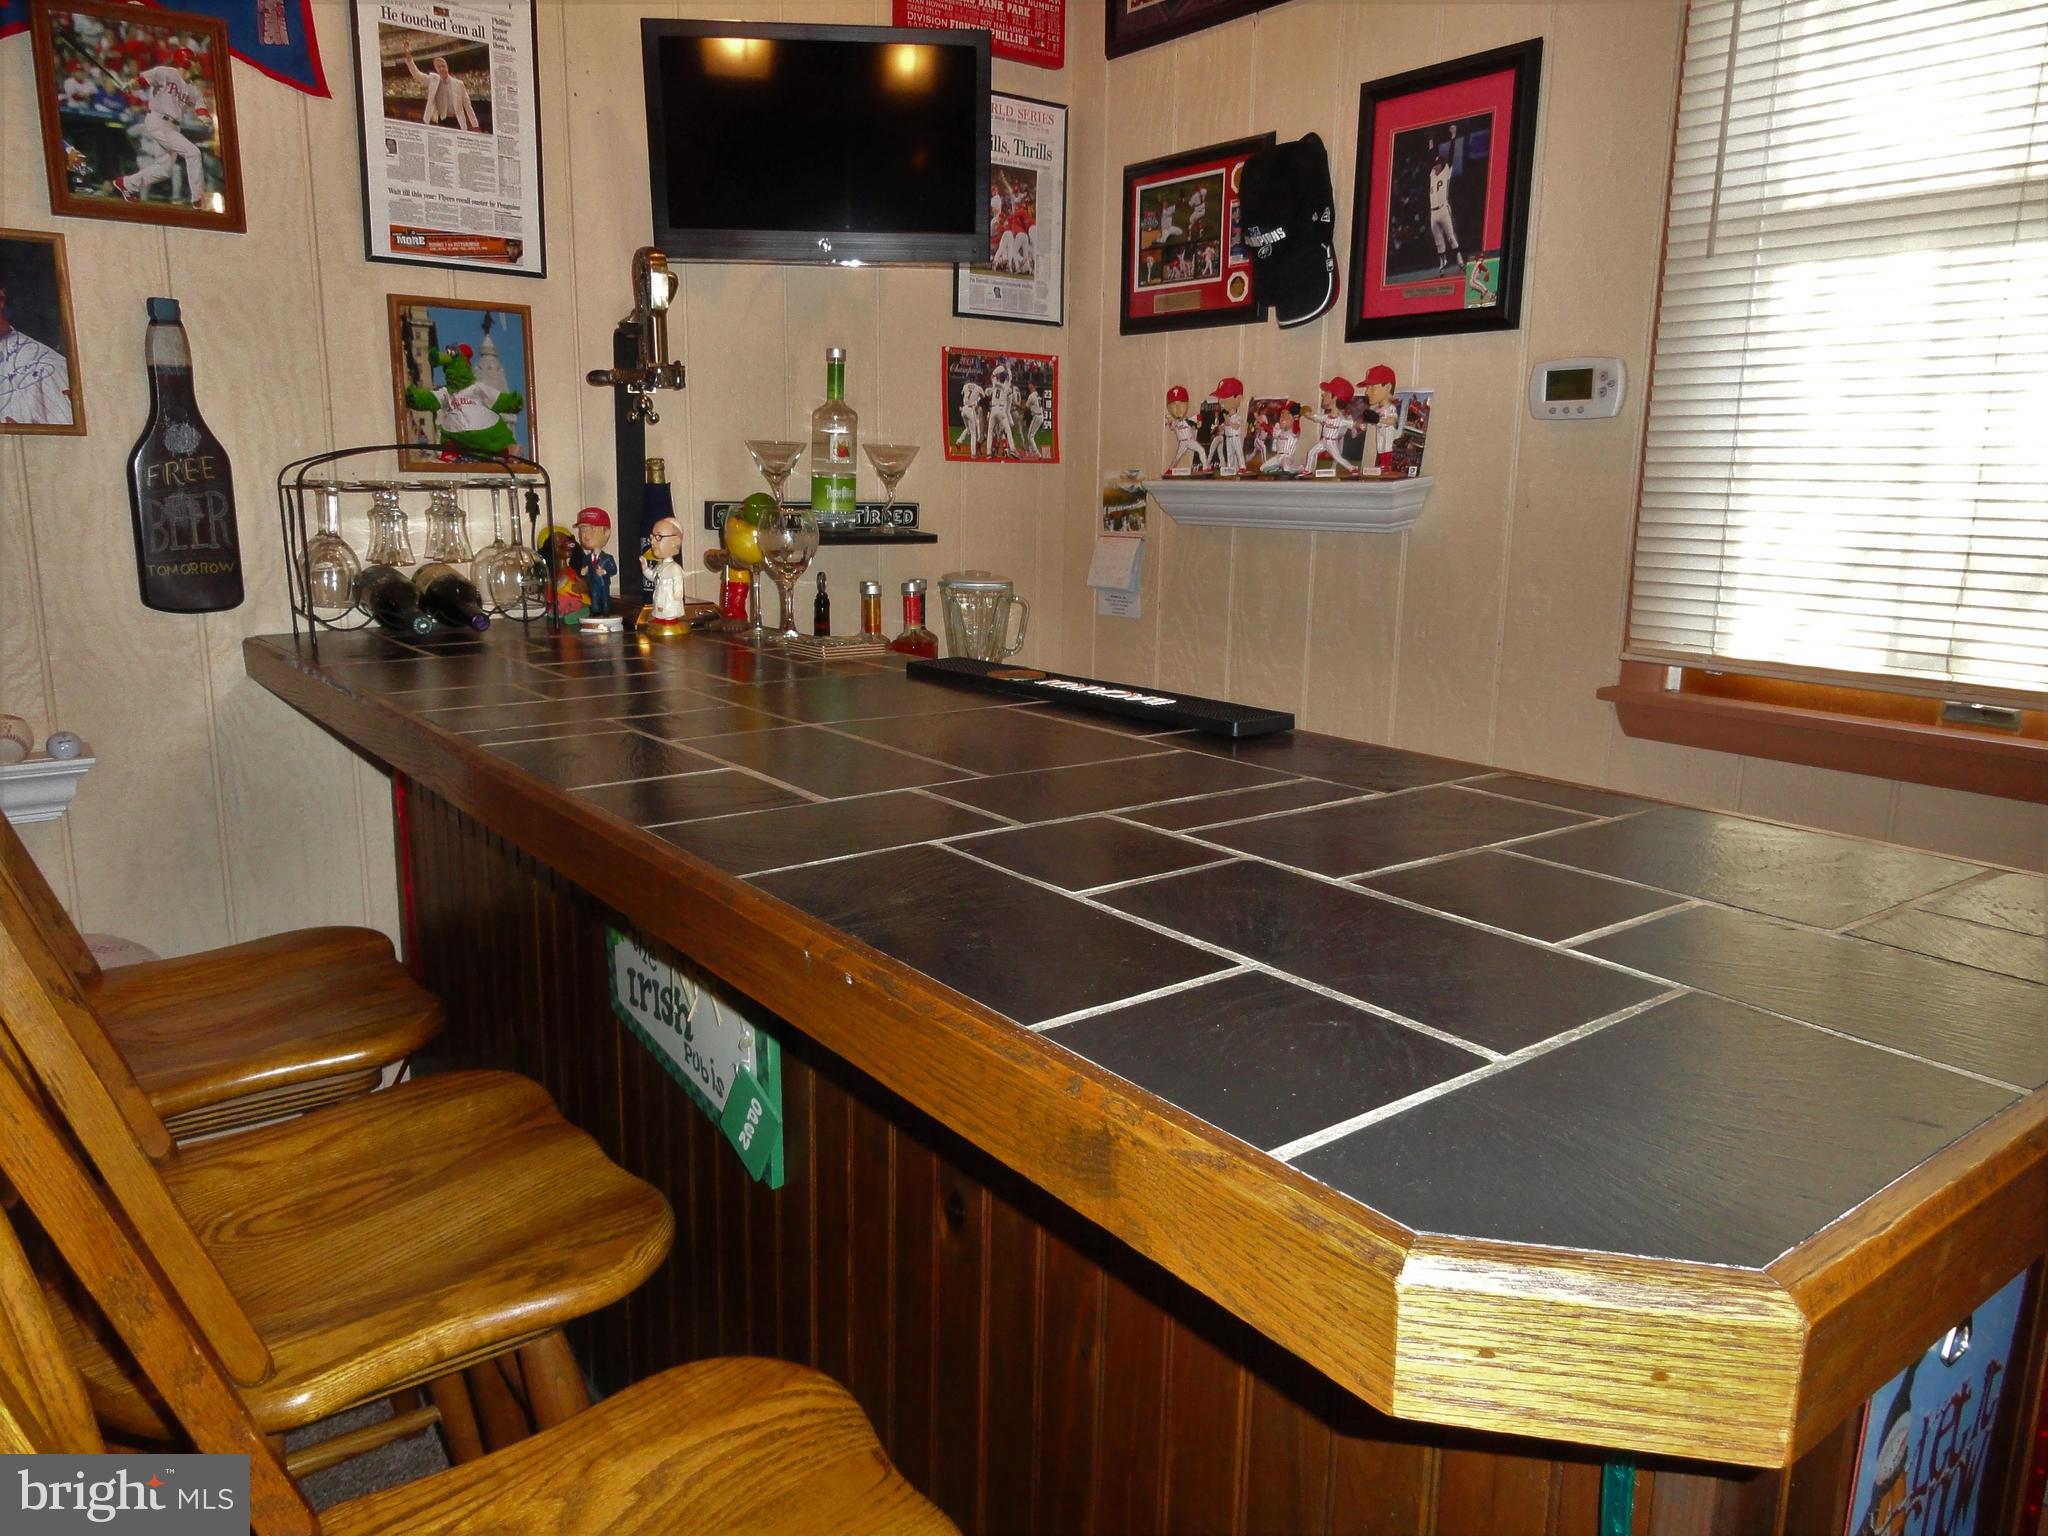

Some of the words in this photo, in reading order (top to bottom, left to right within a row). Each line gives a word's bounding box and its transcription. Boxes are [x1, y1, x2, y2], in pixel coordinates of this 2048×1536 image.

[380, 6, 397, 20] He
[401, 11, 447, 31] touched
[449, 20, 469, 35] 'em
[471, 25, 486, 39] all
[907, 11, 948, 28] DIVISION
[1007, 3, 1030, 17] PARK
[990, 28, 1029, 46] PHILLIES
[991, 102, 1014, 117] RLD
[1017, 108, 1055, 126] SERIES
[990, 134, 1010, 157] ills,
[1013, 138, 1053, 162] Thrills
[146, 455, 216, 489] FREE
[149, 488, 231, 553] BEER
[147, 561, 236, 577] TOMORROW
[627, 967, 693, 1042] Irish
